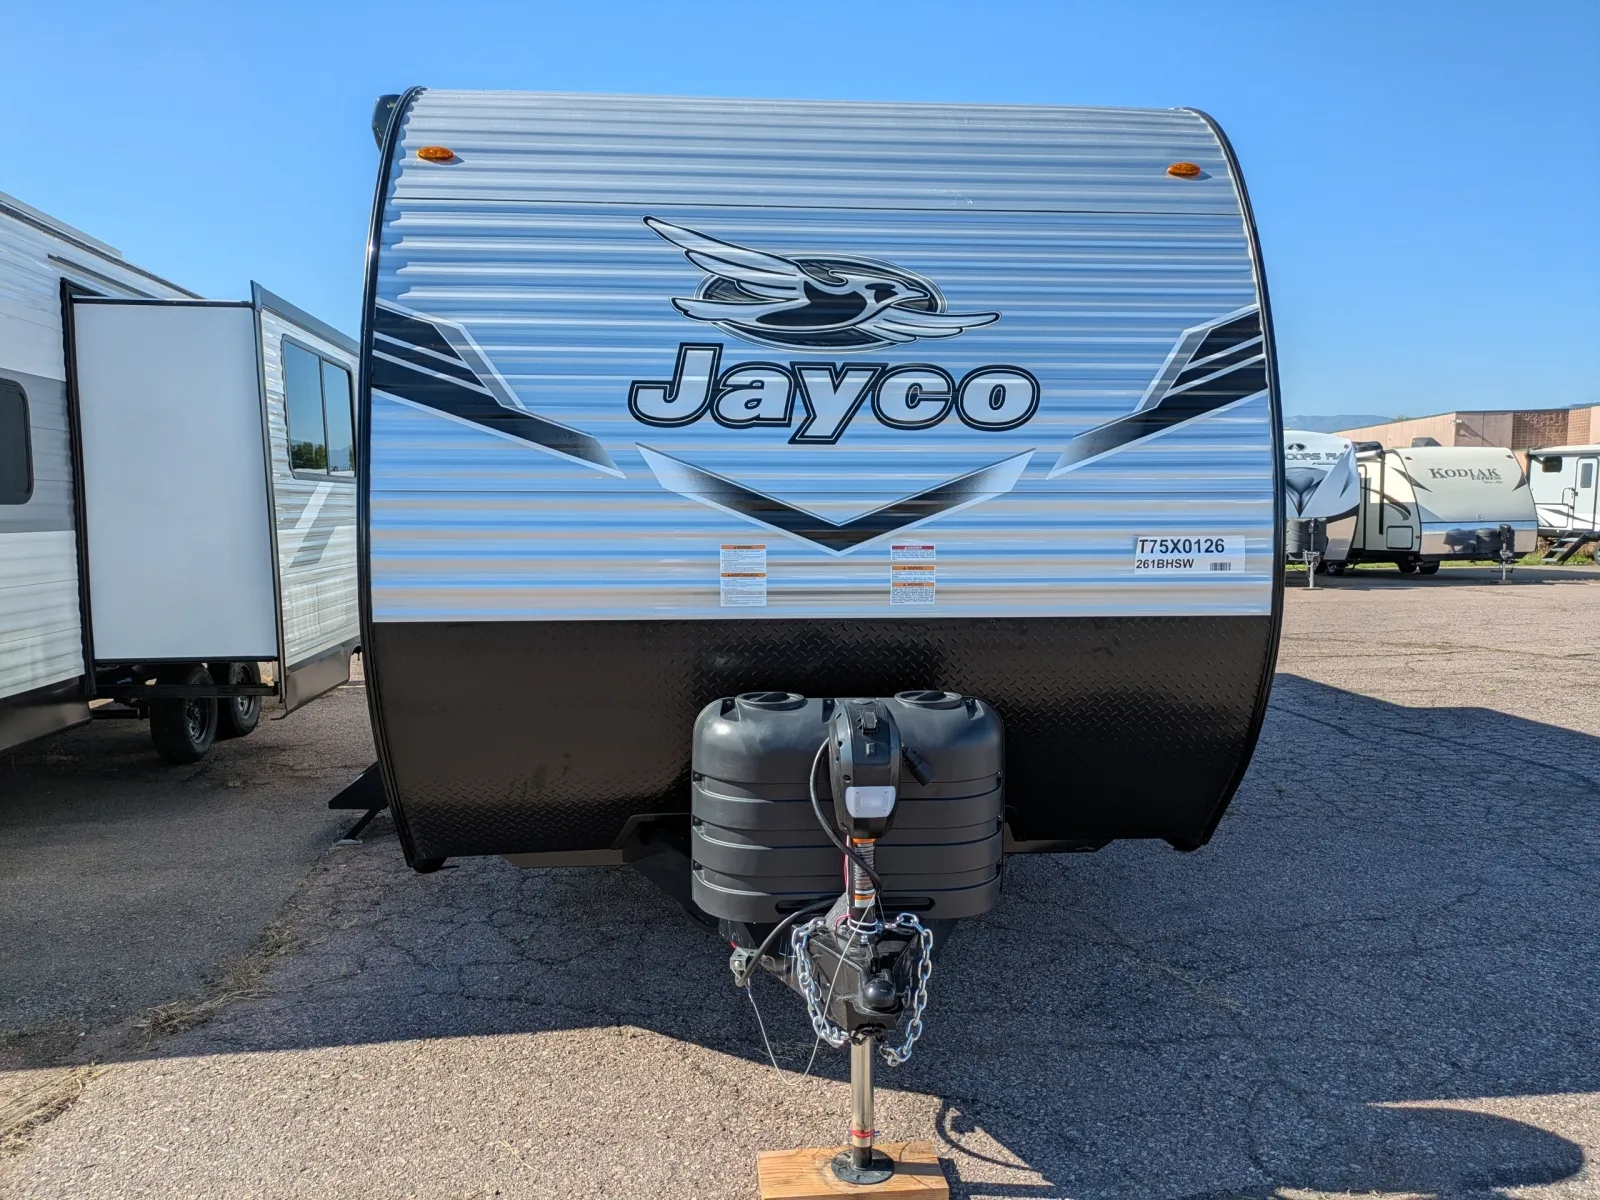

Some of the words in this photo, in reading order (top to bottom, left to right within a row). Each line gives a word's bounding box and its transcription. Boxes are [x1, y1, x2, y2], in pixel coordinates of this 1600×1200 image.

[628, 342, 1040, 444] Jayco
[1428, 468, 1501, 479] KODIAK
[1139, 538, 1225, 554] T75X0126
[1136, 558, 1194, 569] 261BHSW
